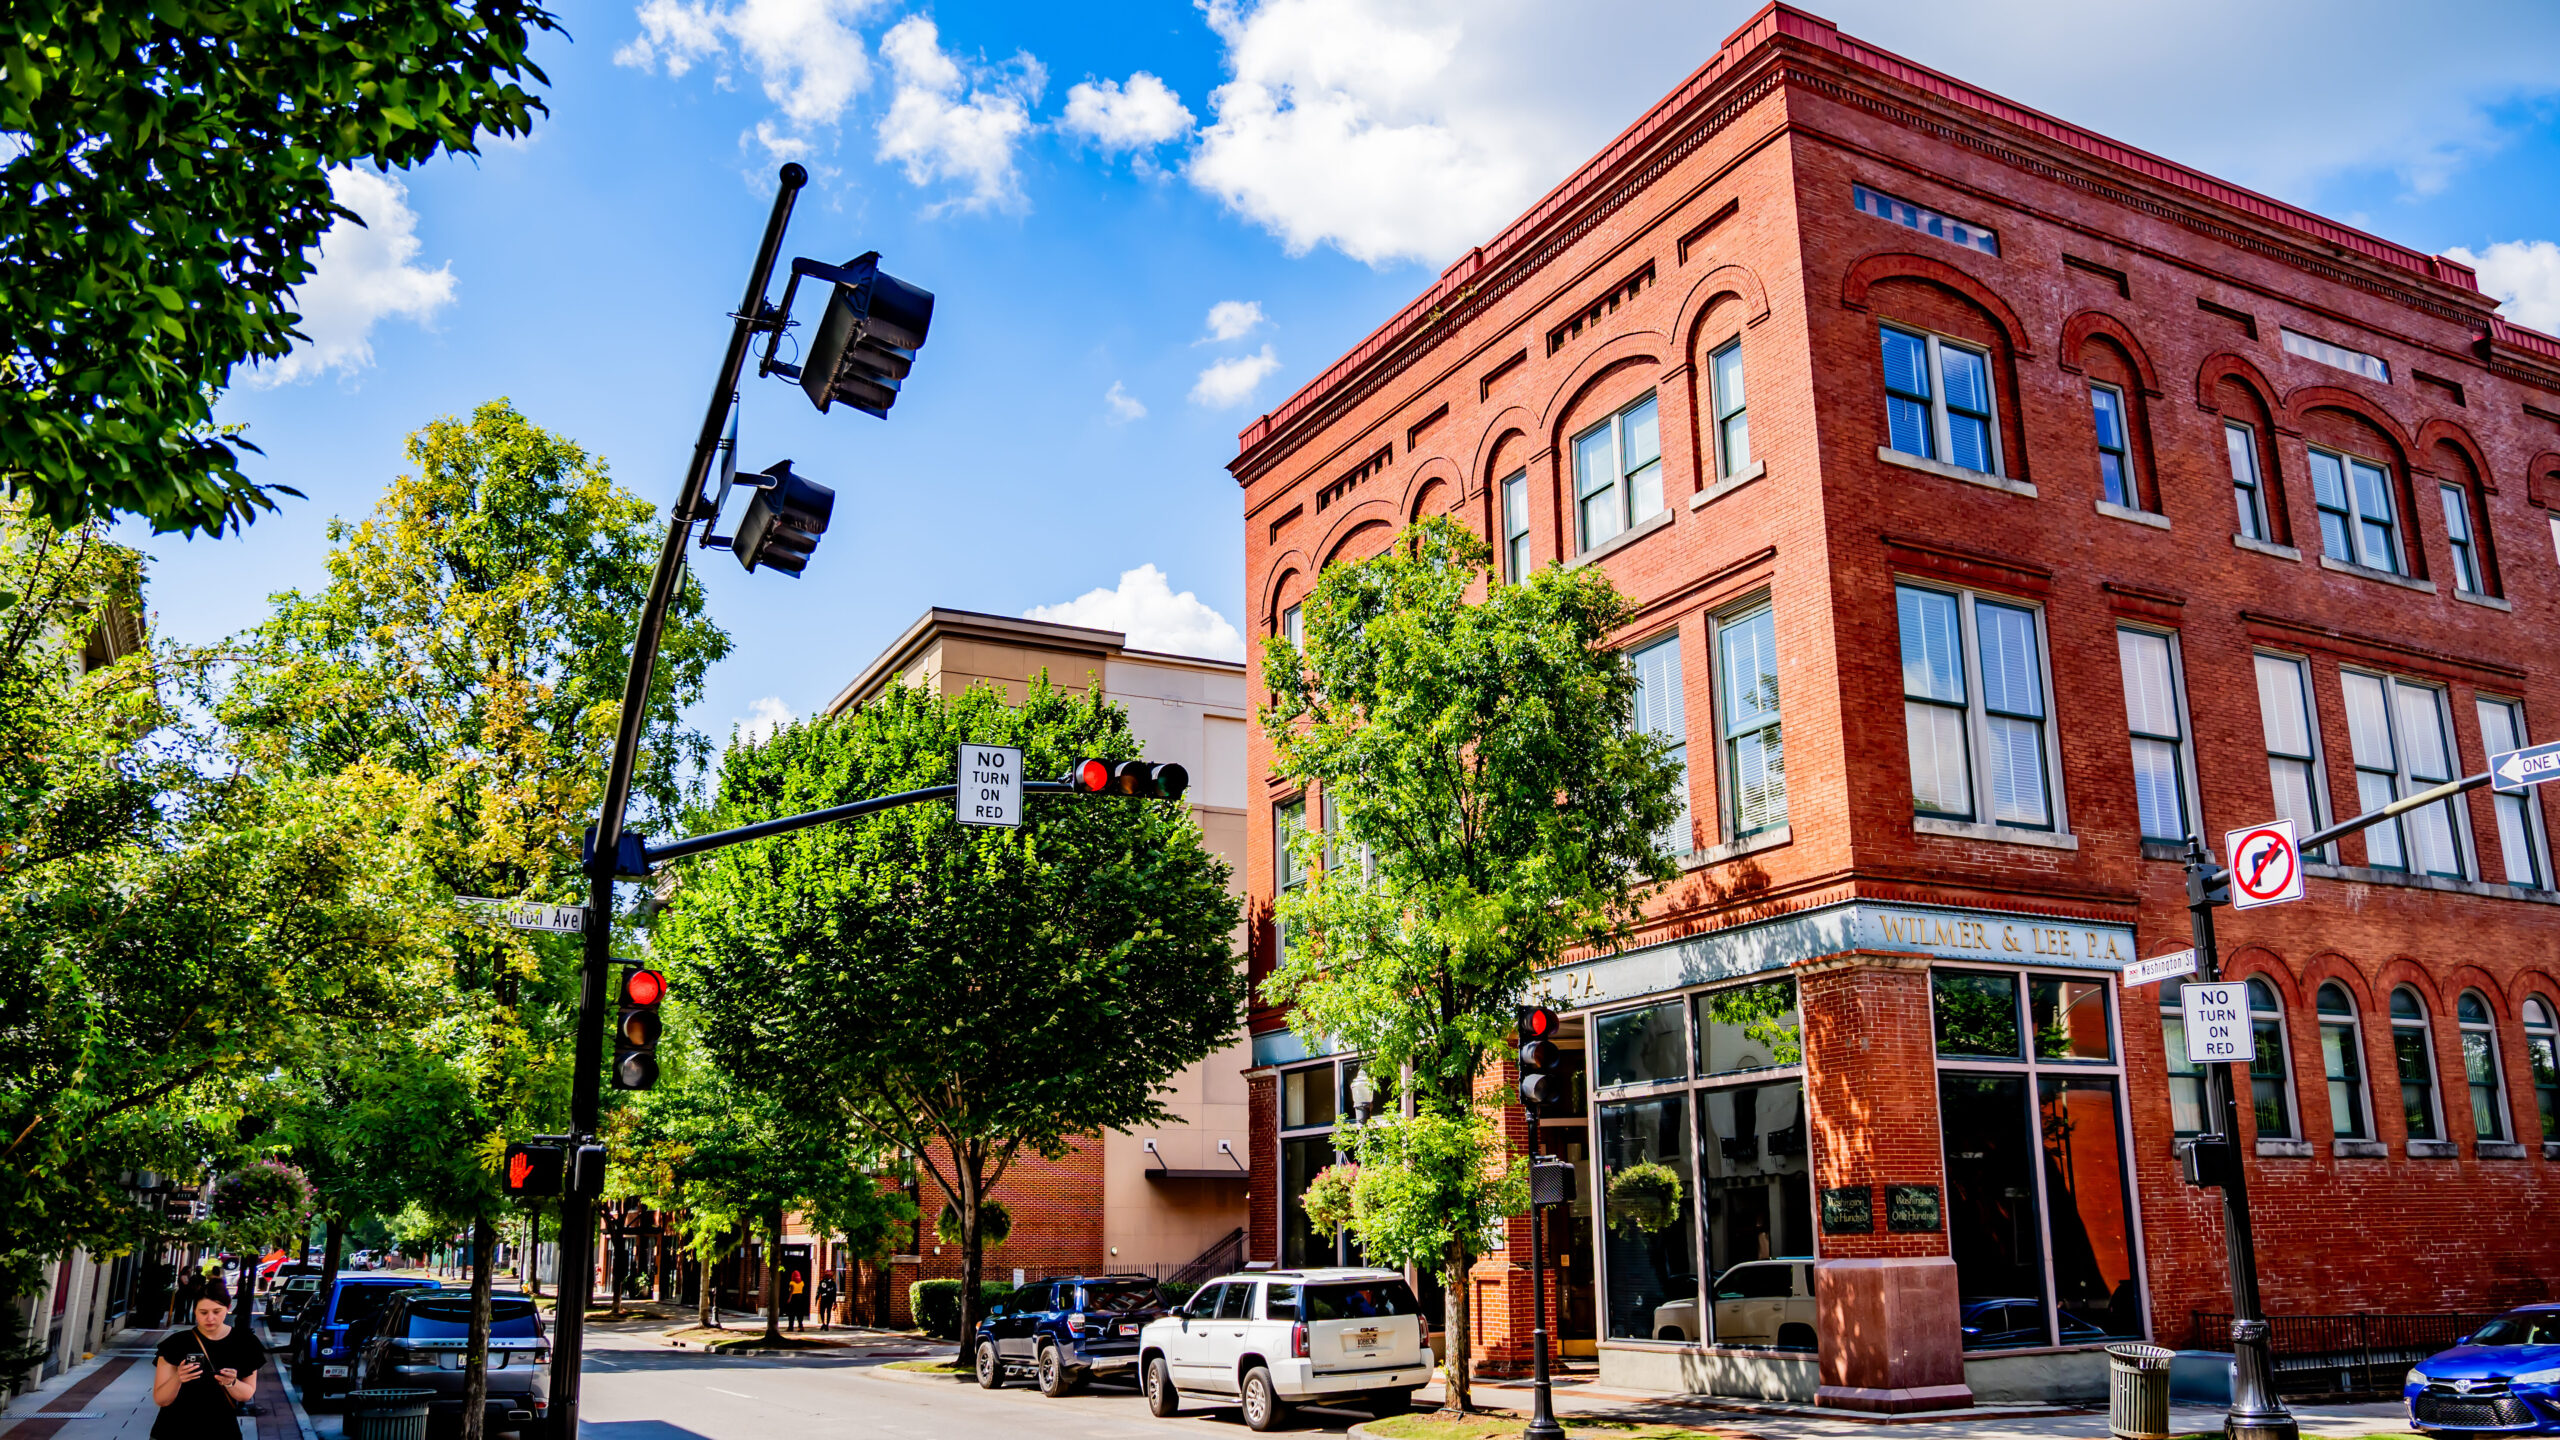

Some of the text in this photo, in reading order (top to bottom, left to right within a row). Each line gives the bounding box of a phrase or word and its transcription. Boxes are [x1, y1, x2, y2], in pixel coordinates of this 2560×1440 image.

[978, 752, 1005, 768] NO
[2523, 755, 2552, 773] ONE
[973, 771, 1010, 785] TURN
[981, 788, 1000, 801] ON
[976, 805, 1003, 818] RED
[553, 908, 579, 929] Ave
[1878, 914, 2126, 961] WILMER & LEE, P.A.
[2141, 956, 2182, 976] Washington
[2185, 952, 2193, 966] St
[1566, 967, 1605, 1001] P.A.
[2201, 990, 2229, 1005] NO
[2198, 1009, 2236, 1022] TURN
[2209, 1025, 2229, 1038] ON
[2206, 1042, 2235, 1055] RED
[1826, 1194, 1864, 1209] Washington
[1895, 1194, 1934, 1207] Washington
[1839, 1212, 1868, 1223] Hundred
[1891, 1210, 1938, 1222] One Hundred
